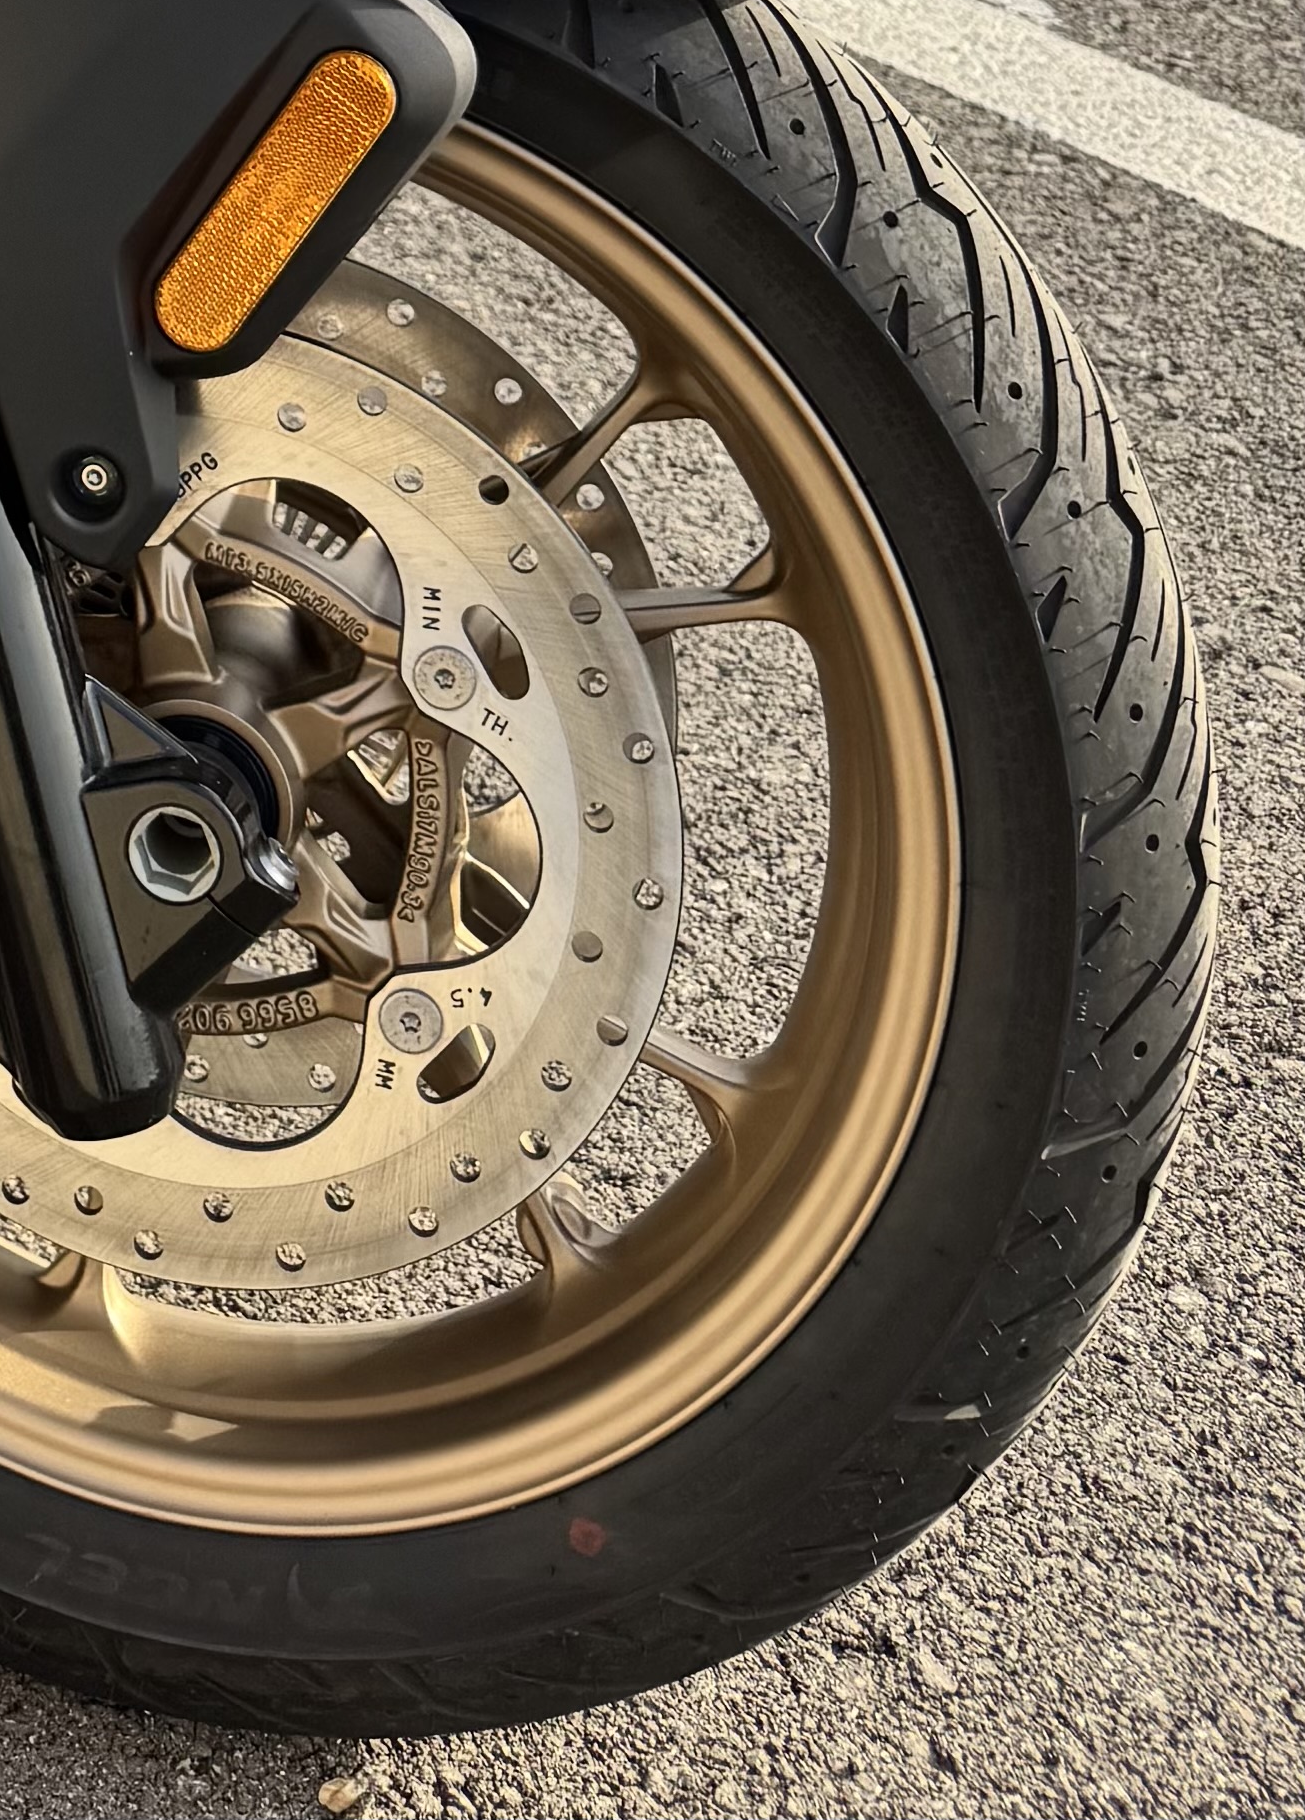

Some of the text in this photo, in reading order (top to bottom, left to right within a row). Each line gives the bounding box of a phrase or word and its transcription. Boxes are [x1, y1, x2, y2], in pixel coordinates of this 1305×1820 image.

[375, 586, 514, 1090] MIN TH. 4.5 MM
